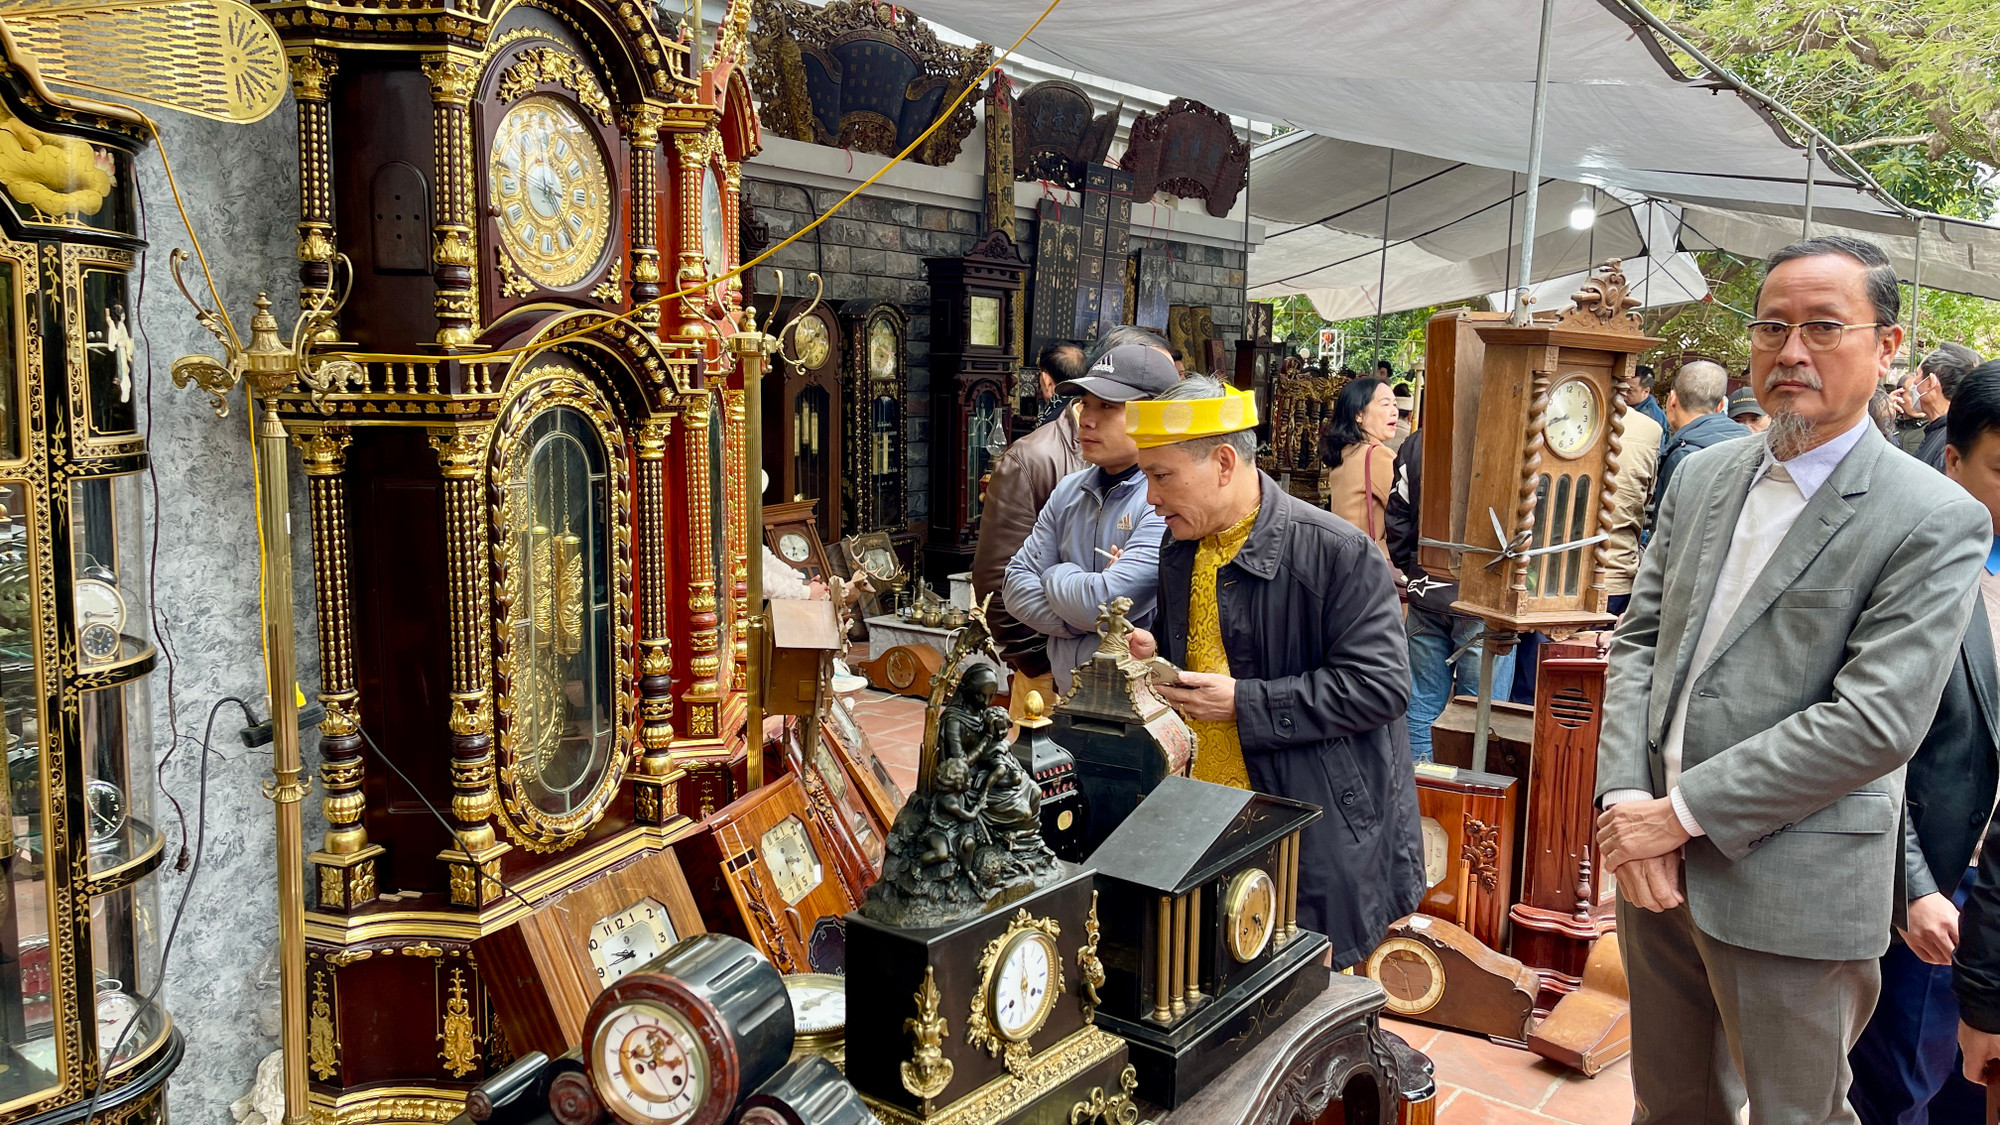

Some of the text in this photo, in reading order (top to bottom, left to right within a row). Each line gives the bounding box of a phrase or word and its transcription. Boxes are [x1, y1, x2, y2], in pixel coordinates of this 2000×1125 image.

[791, 825, 797, 836] 2
[800, 843, 806, 854] 3
[789, 886, 795, 897] 7
[802, 876, 808, 886] 5
[603, 908, 654, 936] 11 12 1 2
[588, 932, 666, 951] 10 3
[597, 967, 605, 978] 9
